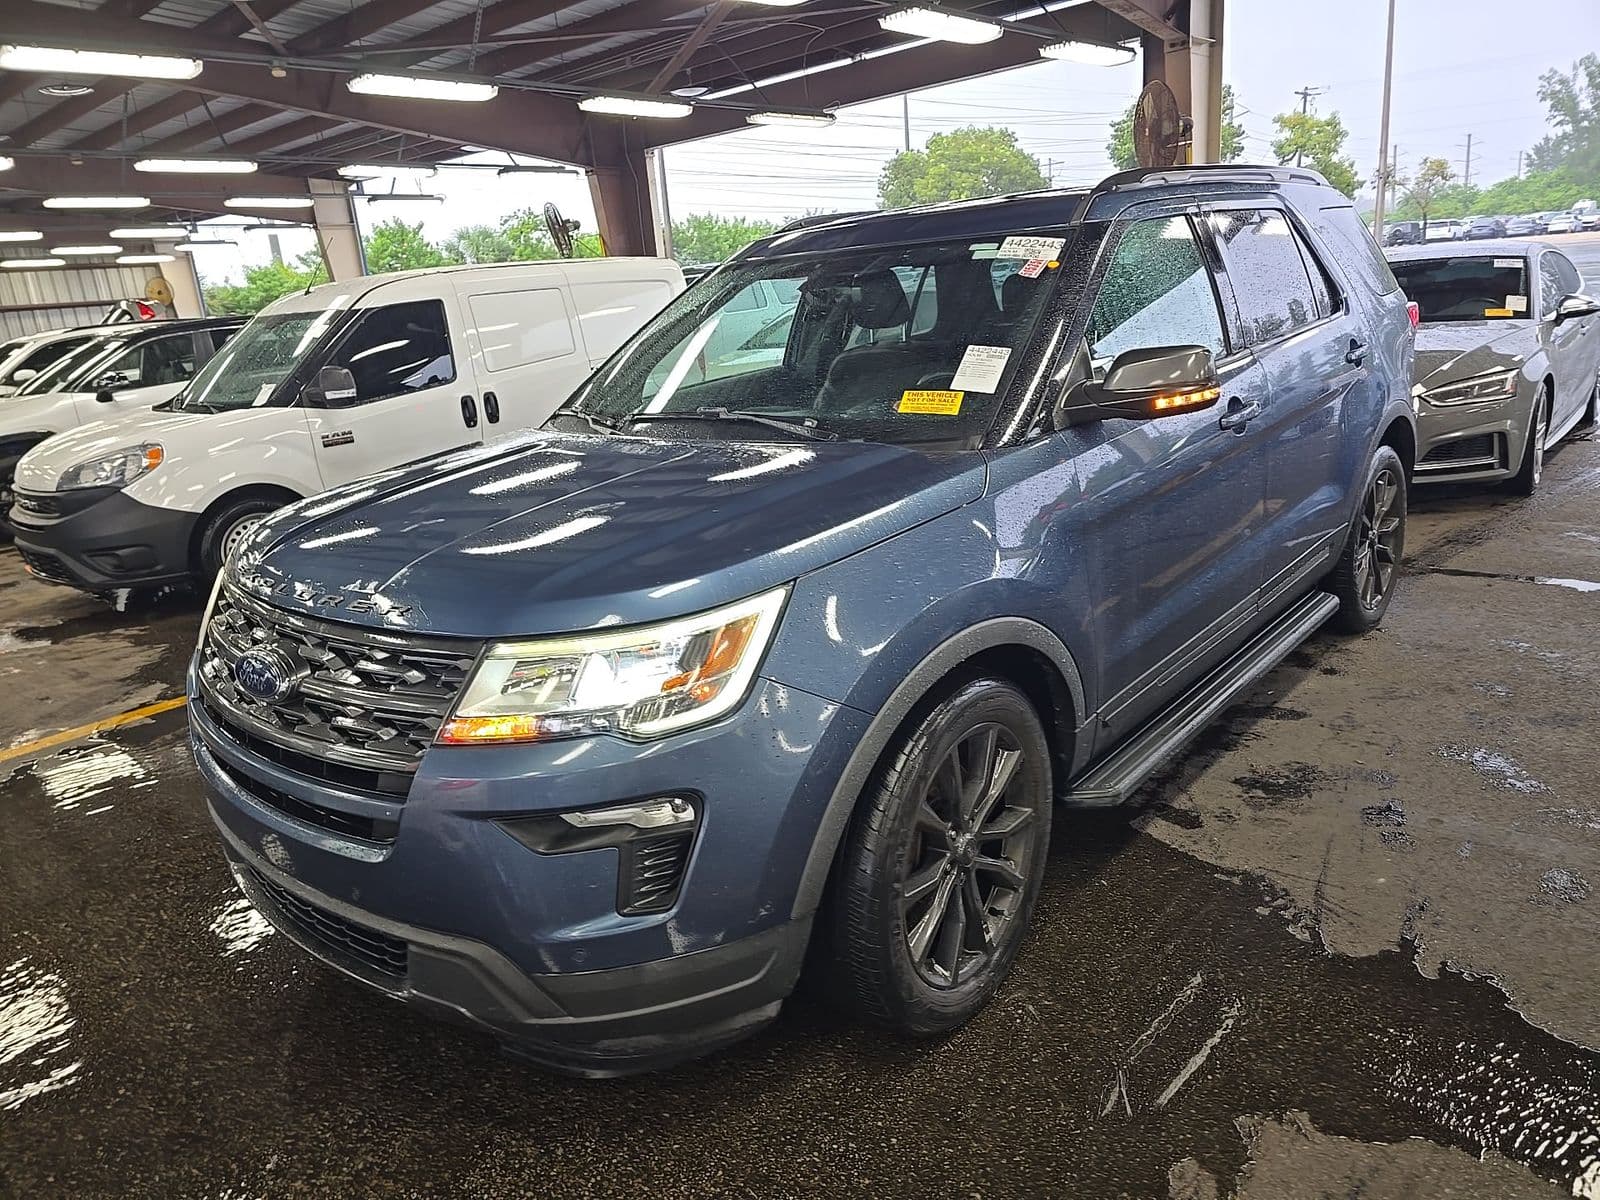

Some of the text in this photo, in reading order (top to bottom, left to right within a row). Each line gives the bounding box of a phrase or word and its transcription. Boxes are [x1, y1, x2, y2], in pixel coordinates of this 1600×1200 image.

[1006, 238, 1064, 250] 4422443
[969, 347, 1010, 356] 4422443
[926, 391, 960, 399] VEHICLE
[239, 658, 277, 691] Ford
